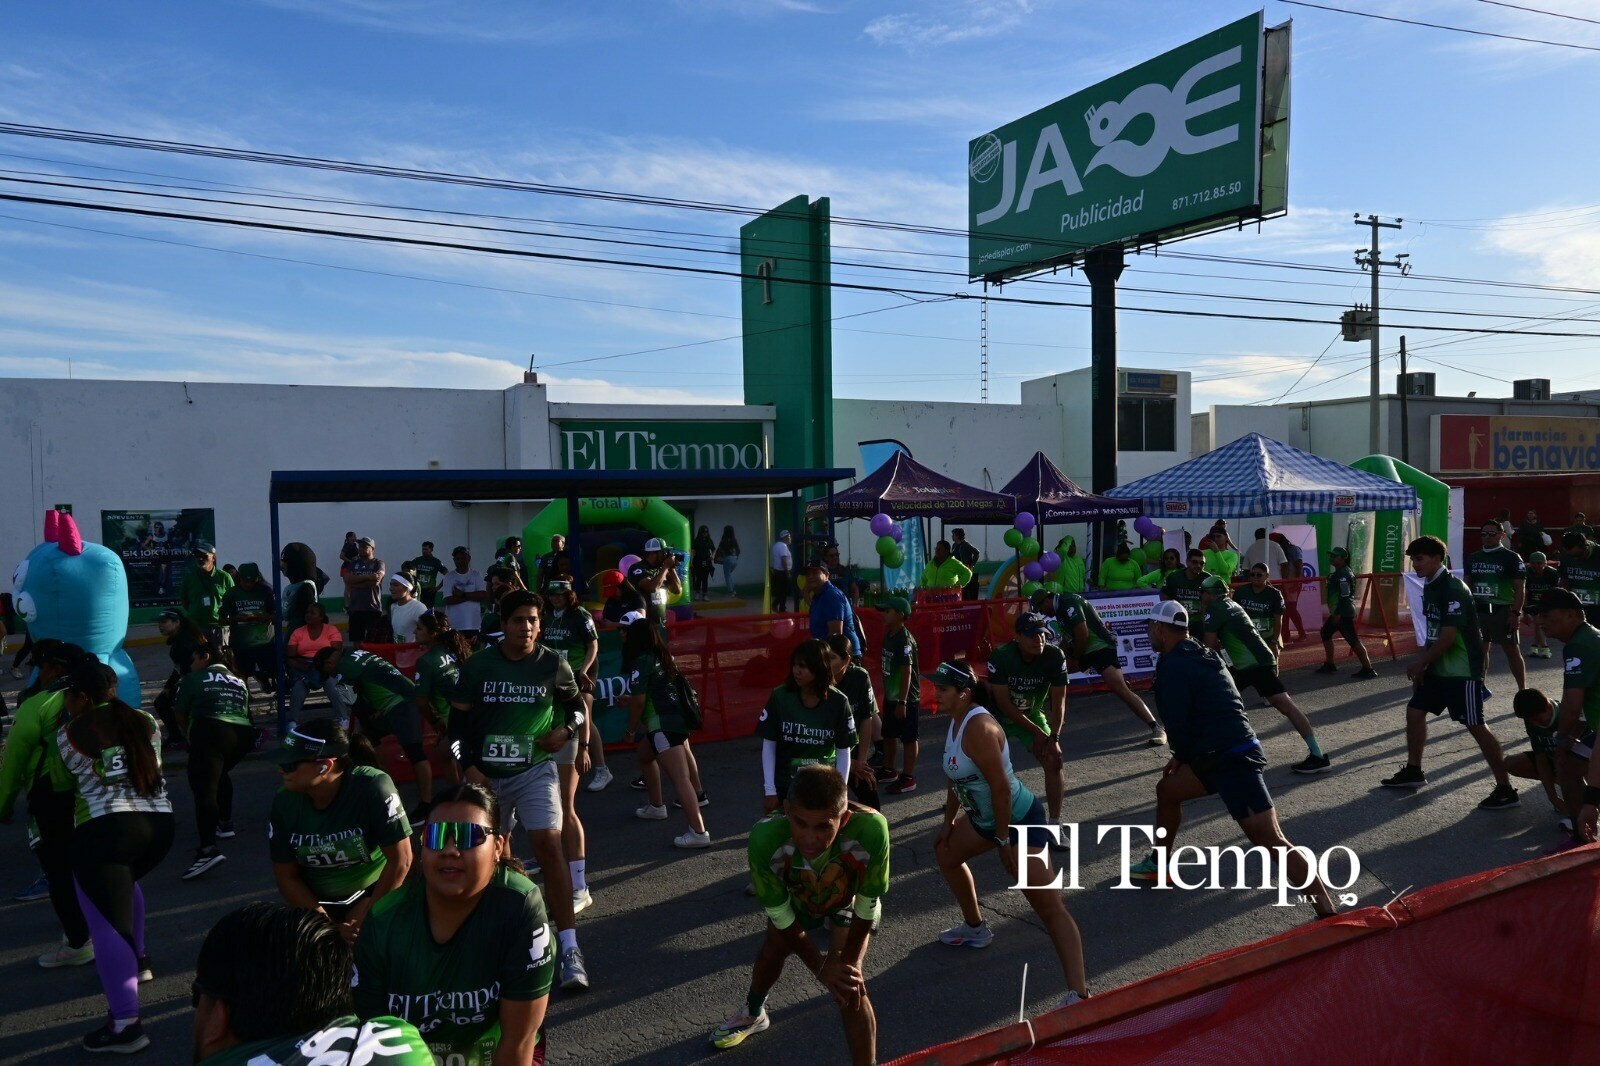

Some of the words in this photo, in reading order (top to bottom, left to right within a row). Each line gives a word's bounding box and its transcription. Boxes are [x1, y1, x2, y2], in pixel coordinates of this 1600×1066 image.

[1172, 180, 1242, 211] 871.712.85.50
[1060, 188, 1145, 233] Publicidad
[977, 242, 1032, 265] jadedisplay.com
[1502, 426, 1547, 442] farmacias
[562, 429, 606, 470] El
[615, 430, 763, 470] Tiempo
[891, 501, 934, 510] Velocidad
[935, 500, 945, 509] de
[946, 499, 966, 509] 1200
[966, 499, 994, 510] Megas
[1166, 503, 1187, 511] BIMBO
[1380, 524, 1400, 572] Tiempo
[1475, 586, 1492, 594] 113
[1098, 610, 1118, 619] ARTES
[1133, 608, 1151, 617] MARZ
[483, 680, 497, 693] El
[498, 680, 547, 697] Tiempo
[483, 695, 497, 703] de
[498, 695, 536, 704] todos
[781, 721, 793, 732] El
[795, 722, 836, 740] Tiempo
[794, 735, 826, 746] todos
[488, 743, 520, 757] 515
[306, 850, 349, 866] 514
[414, 979, 501, 1020] Tiempo
[481, 1040, 495, 1048] 100
